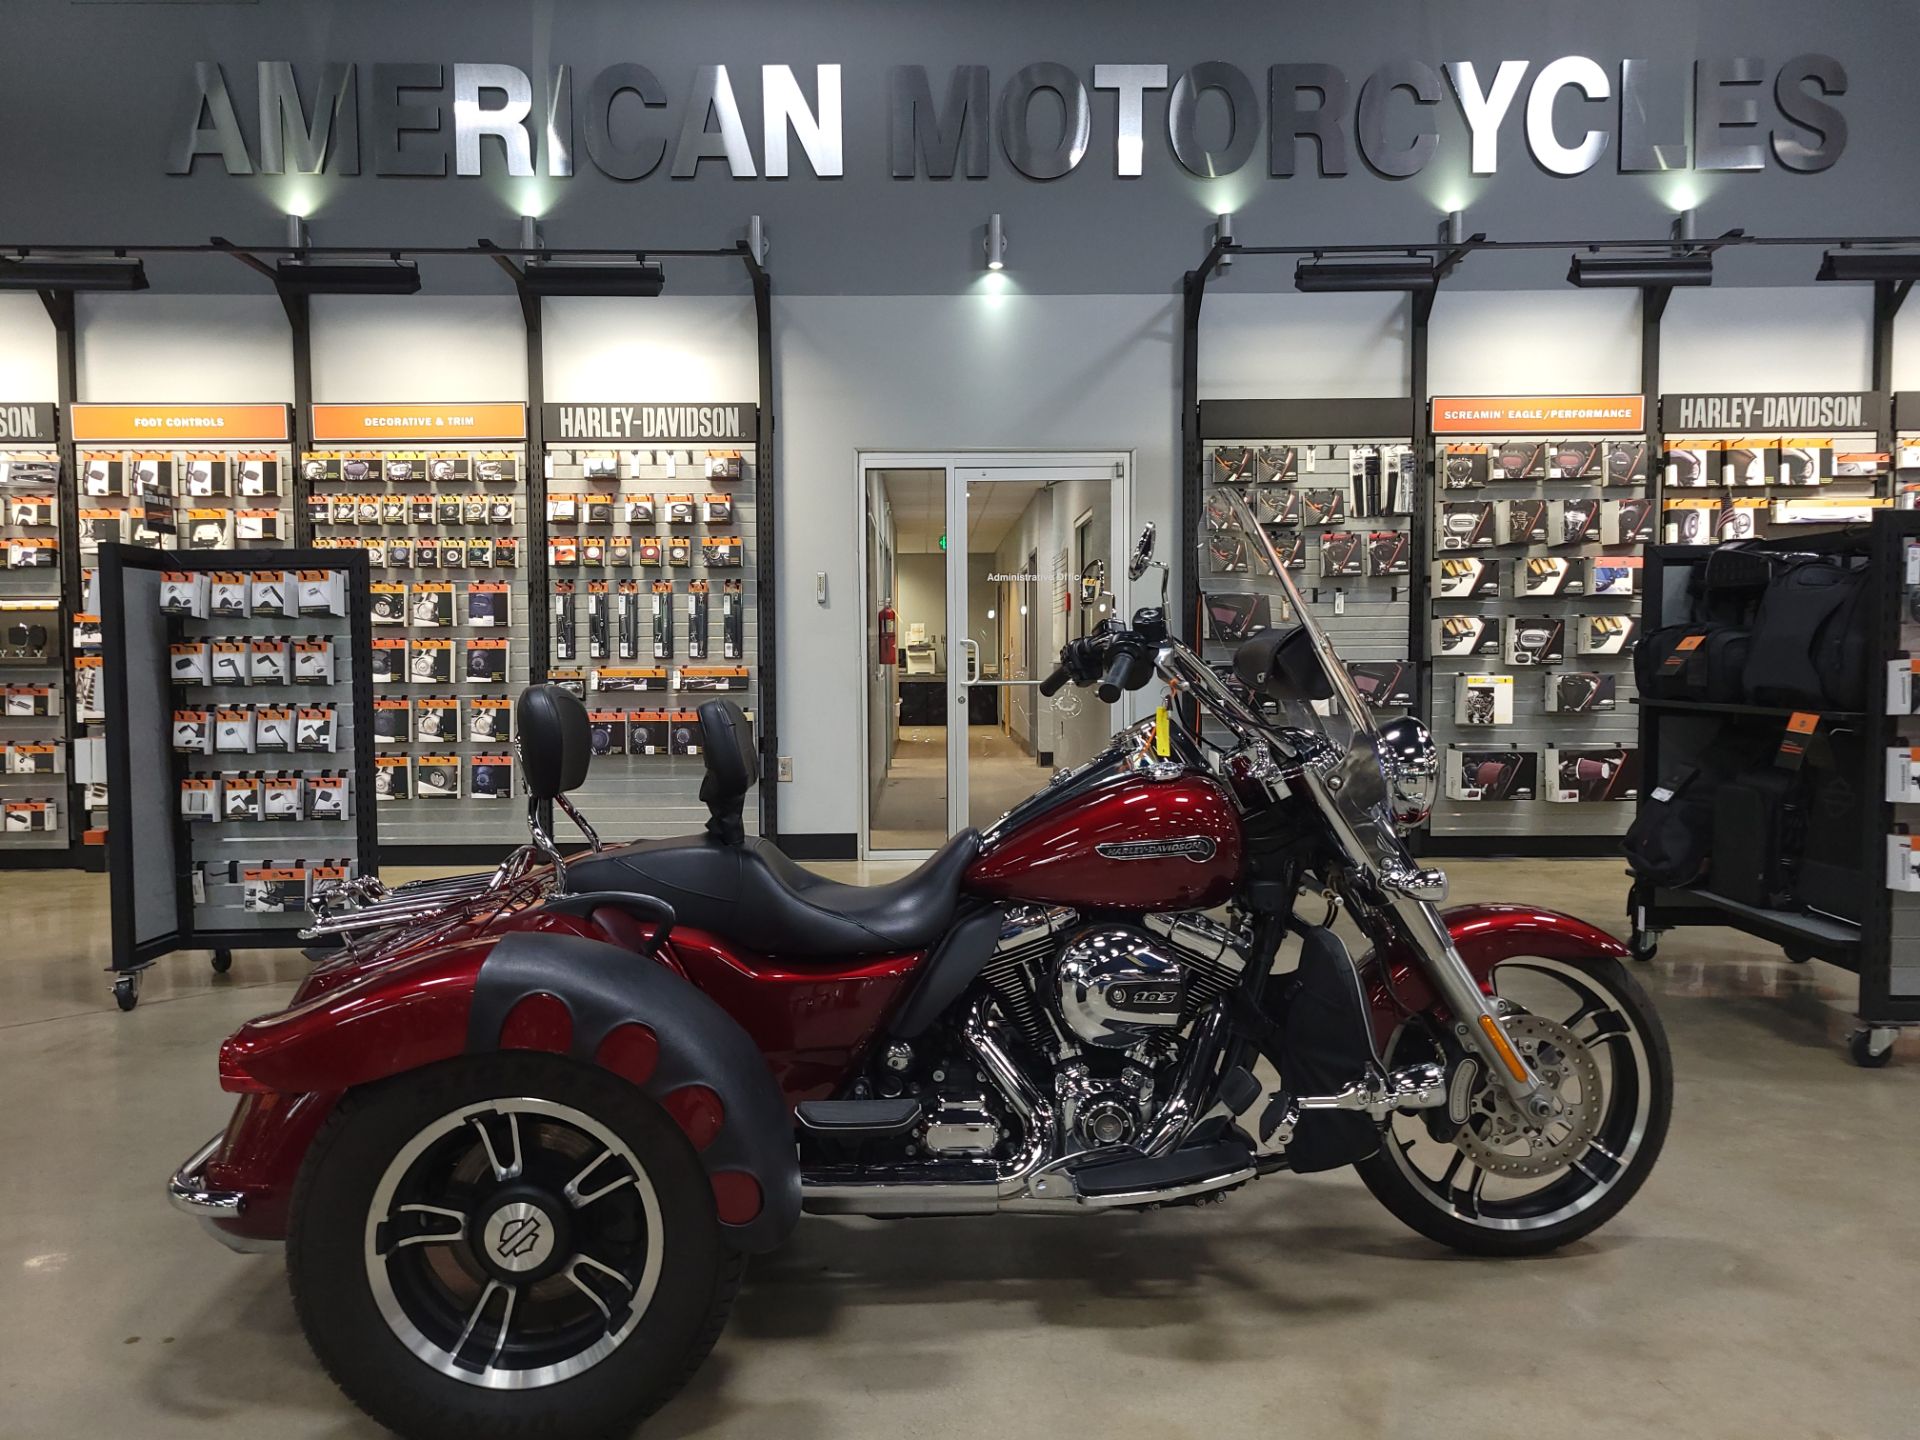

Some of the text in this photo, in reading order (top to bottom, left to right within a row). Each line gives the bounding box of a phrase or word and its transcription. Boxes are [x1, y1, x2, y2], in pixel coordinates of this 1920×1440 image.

[165, 55, 1849, 181] AMERICAN MOTORCYCLES
[1444, 410, 1505, 420] SCREAMIN'
[1679, 396, 1863, 429] HARLEY-DAVIDSON
[134, 417, 225, 428] FOOT CONTROLS
[364, 416, 475, 427] DECORATIVE & TRIM
[559, 406, 740, 438] HARLEY-DAVIDSON
[987, 573, 1053, 582] Administrative
